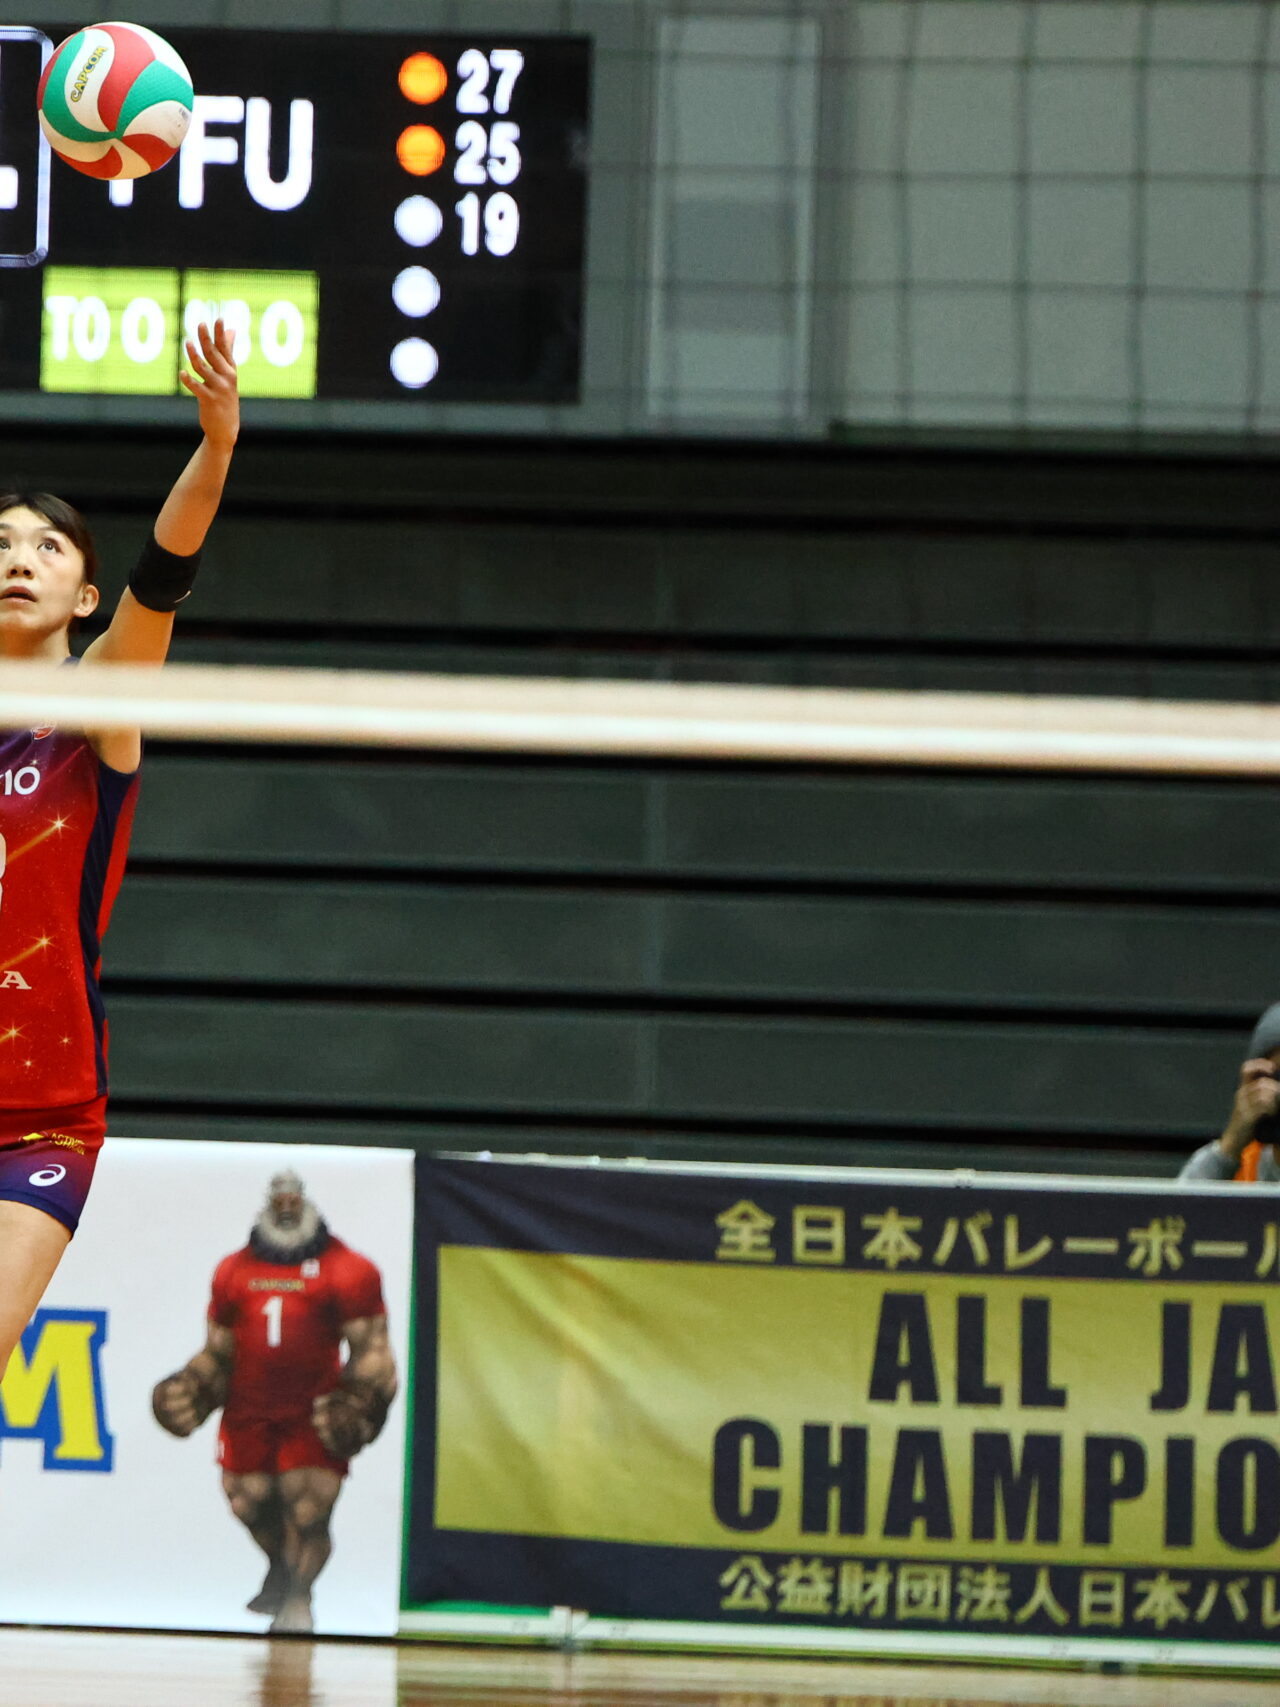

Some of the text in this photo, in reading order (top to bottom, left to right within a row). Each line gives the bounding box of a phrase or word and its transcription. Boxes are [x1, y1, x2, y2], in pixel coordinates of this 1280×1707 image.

[70, 46, 108, 103] CAPCOM
[456, 50, 523, 113] 27
[109, 96, 313, 210] FU
[455, 121, 520, 184] 25
[455, 192, 519, 256] 19
[46, 296, 110, 362] TO
[121, 297, 165, 363] 0
[260, 300, 305, 368] 0
[262, 1296, 283, 1347] 1
[869, 1290, 1278, 1413] ALL JA
[712, 1418, 1280, 1551] CHAMPIO
